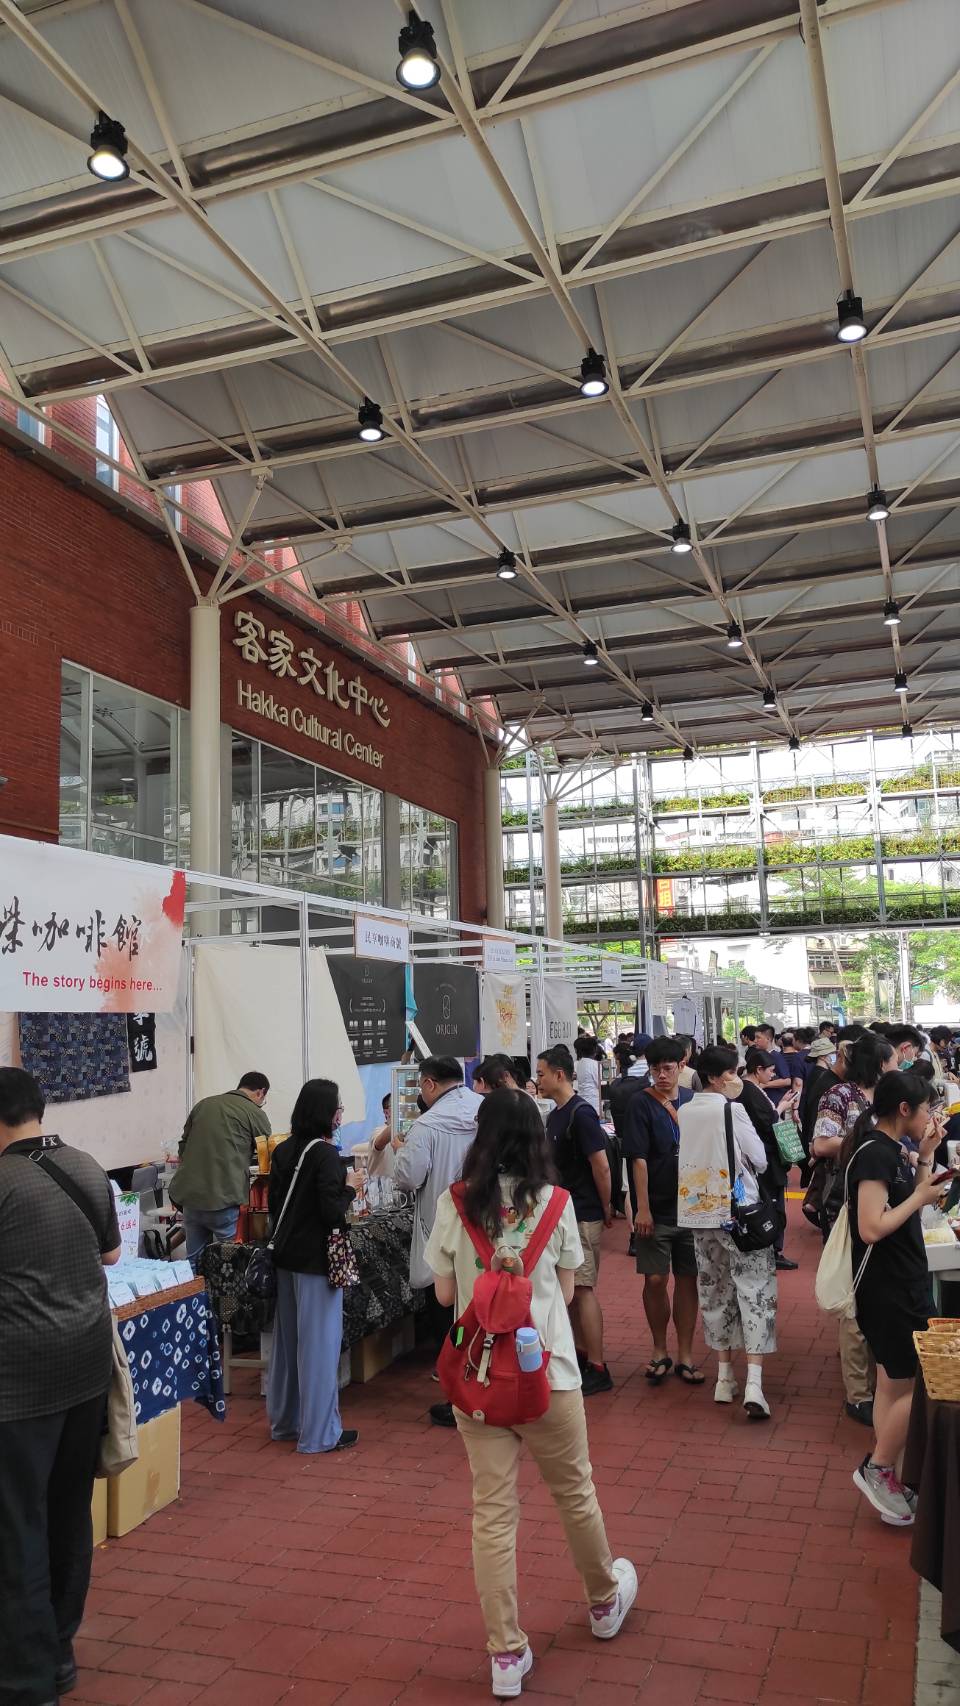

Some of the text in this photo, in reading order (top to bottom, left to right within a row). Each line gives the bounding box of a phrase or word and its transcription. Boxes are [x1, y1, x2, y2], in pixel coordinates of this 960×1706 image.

[233, 611, 390, 727] 客家文化中心
[237, 680, 384, 769] Hakka Cultural Center
[22, 971, 49, 987] The
[53, 975, 85, 991] story
[89, 976, 127, 992] begins
[435, 1023, 458, 1035] ORIGIN
